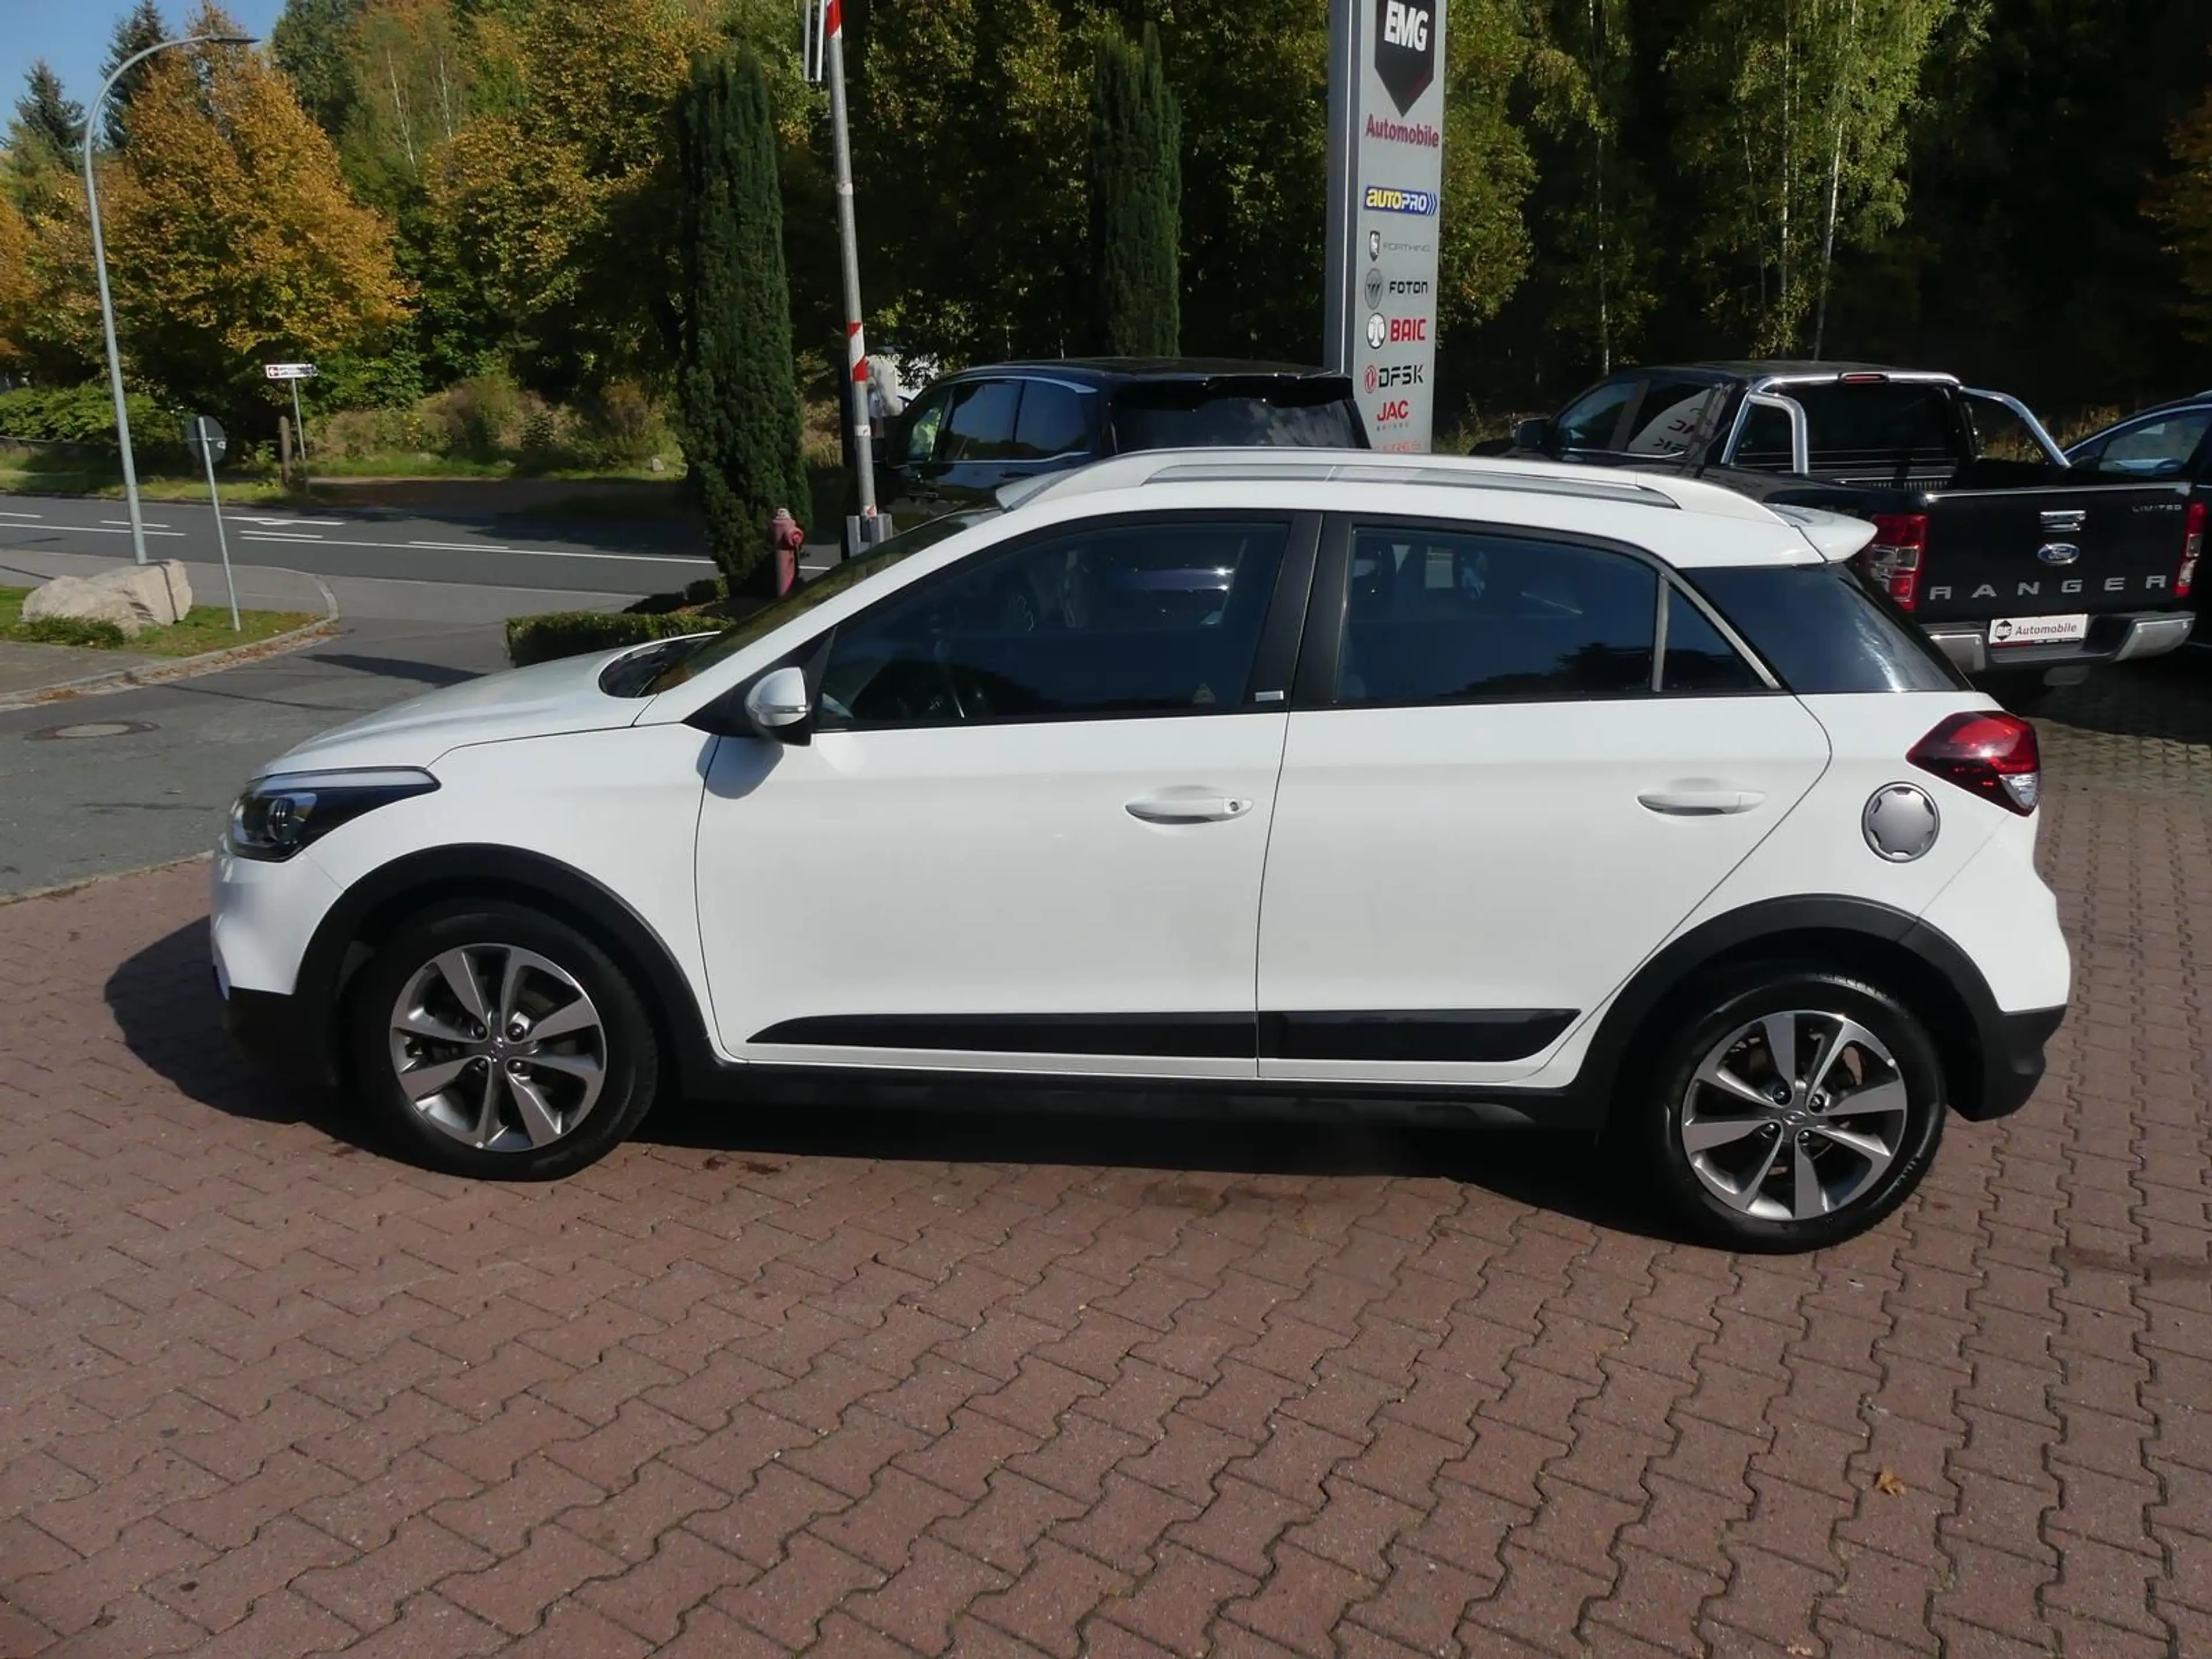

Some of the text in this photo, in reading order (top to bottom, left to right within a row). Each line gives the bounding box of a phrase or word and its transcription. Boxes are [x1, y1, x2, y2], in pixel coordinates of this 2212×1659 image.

[1384, 1, 1429, 51] EMG
[1366, 113, 1439, 148] Automobile
[1389, 281, 1428, 294] FOTON
[1390, 319, 1426, 342] BAIC
[1378, 364, 1424, 388] DFSK
[1377, 400, 1408, 421] JAC
[1929, 575, 2166, 600] RANGER
[2015, 623, 2077, 635] Automobile
